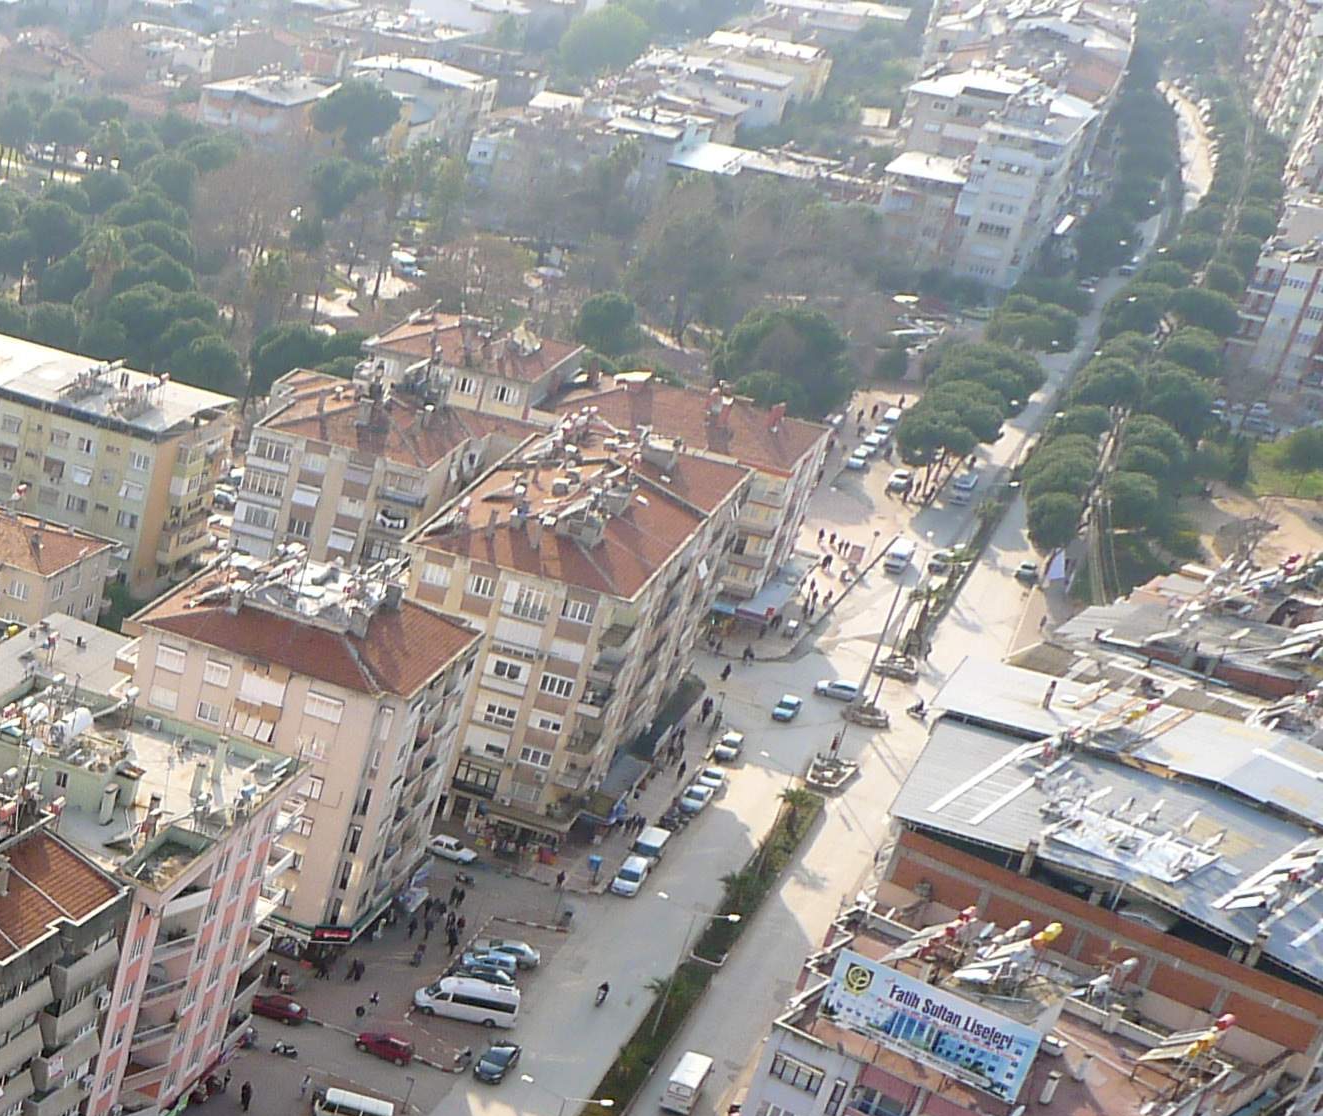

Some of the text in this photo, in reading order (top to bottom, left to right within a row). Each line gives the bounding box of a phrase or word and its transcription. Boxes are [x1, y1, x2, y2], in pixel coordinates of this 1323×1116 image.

[889, 984, 921, 1009] Fatih
[922, 999, 962, 1027] Sultan
[963, 1016, 1015, 1049] Liseleri
